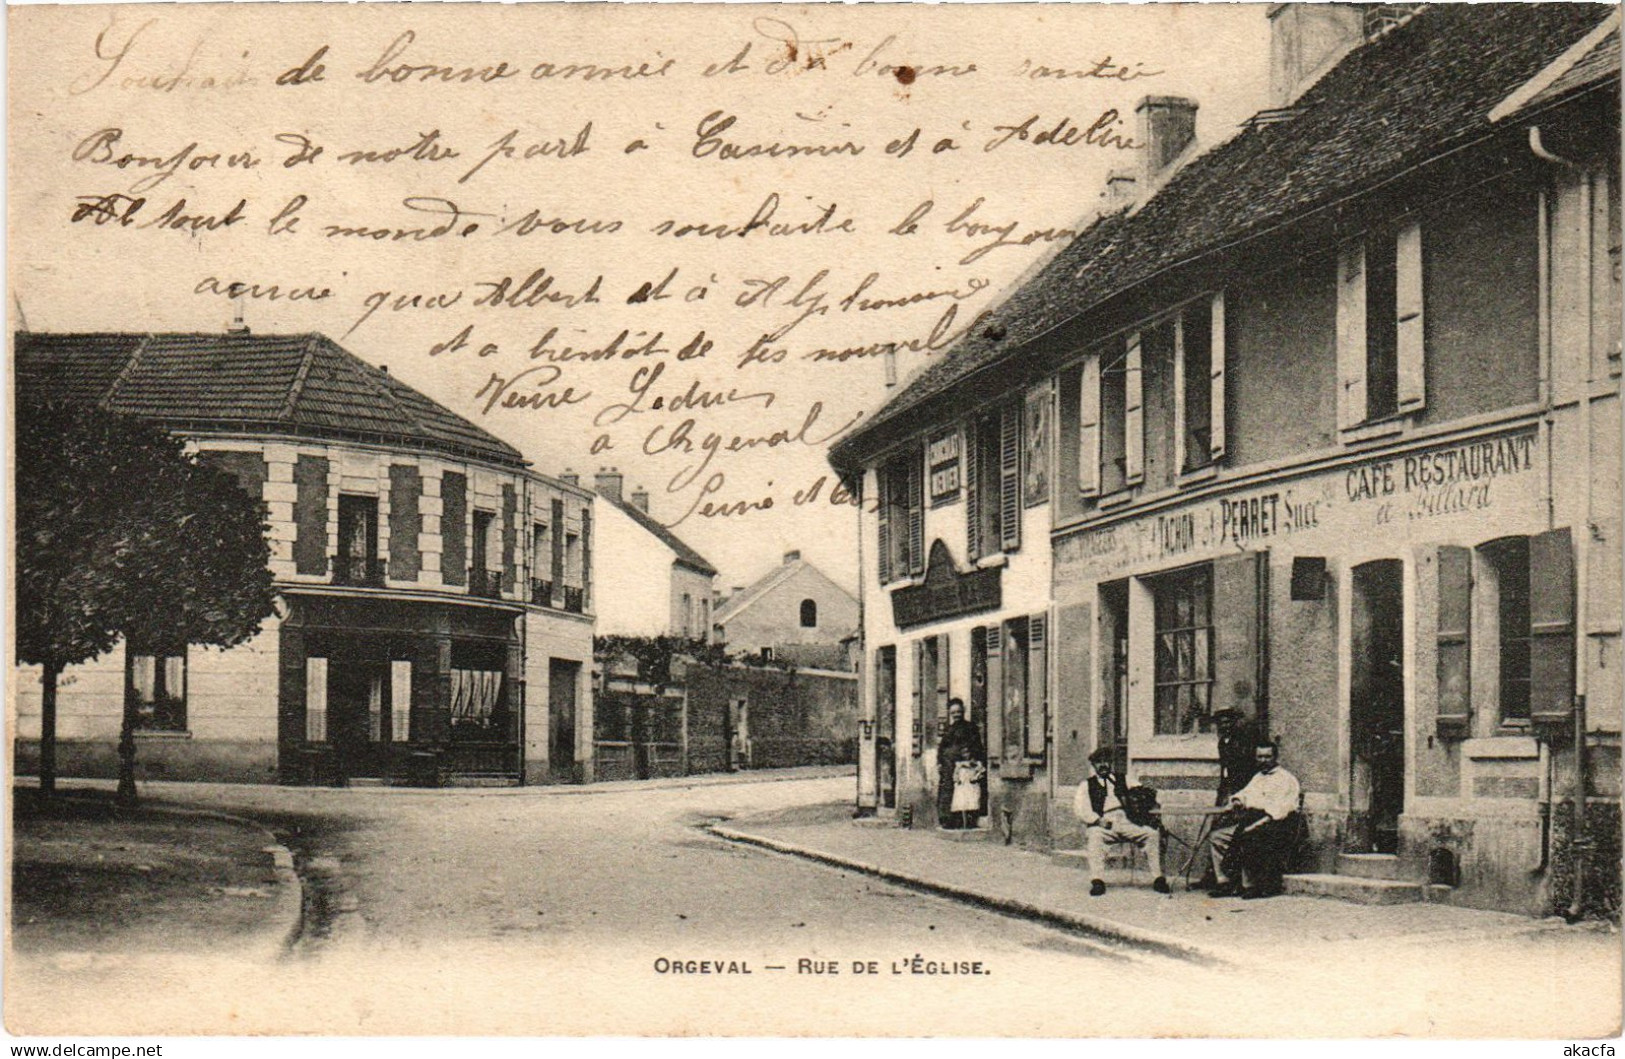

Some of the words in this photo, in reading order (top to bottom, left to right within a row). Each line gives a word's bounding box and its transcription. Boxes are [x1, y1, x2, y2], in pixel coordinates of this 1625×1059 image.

[275, 45, 330, 86] de
[356, 30, 520, 83] bonne
[702, 41, 749, 77] et
[71, 127, 261, 194] Bonjour
[274, 132, 324, 168] de
[337, 129, 460, 165] notre
[457, 121, 592, 184] part
[692, 108, 865, 160] Casimir
[884, 127, 921, 158] et
[136, 198, 247, 231] tout
[267, 194, 308, 235] le
[324, 196, 497, 241] monde
[492, 208, 624, 236] vous
[650, 192, 856, 240] souhaite
[888, 199, 934, 236] le
[473, 267, 600, 308] Albert
[626, 267, 678, 305] et
[428, 324, 474, 357] et
[676, 330, 714, 362] de
[474, 364, 593, 416] Veuve
[593, 361, 776, 427] Leduc
[642, 402, 863, 493] Orgeval
[793, 475, 827, 506] et
[1219, 493, 1280, 546] PERRET
